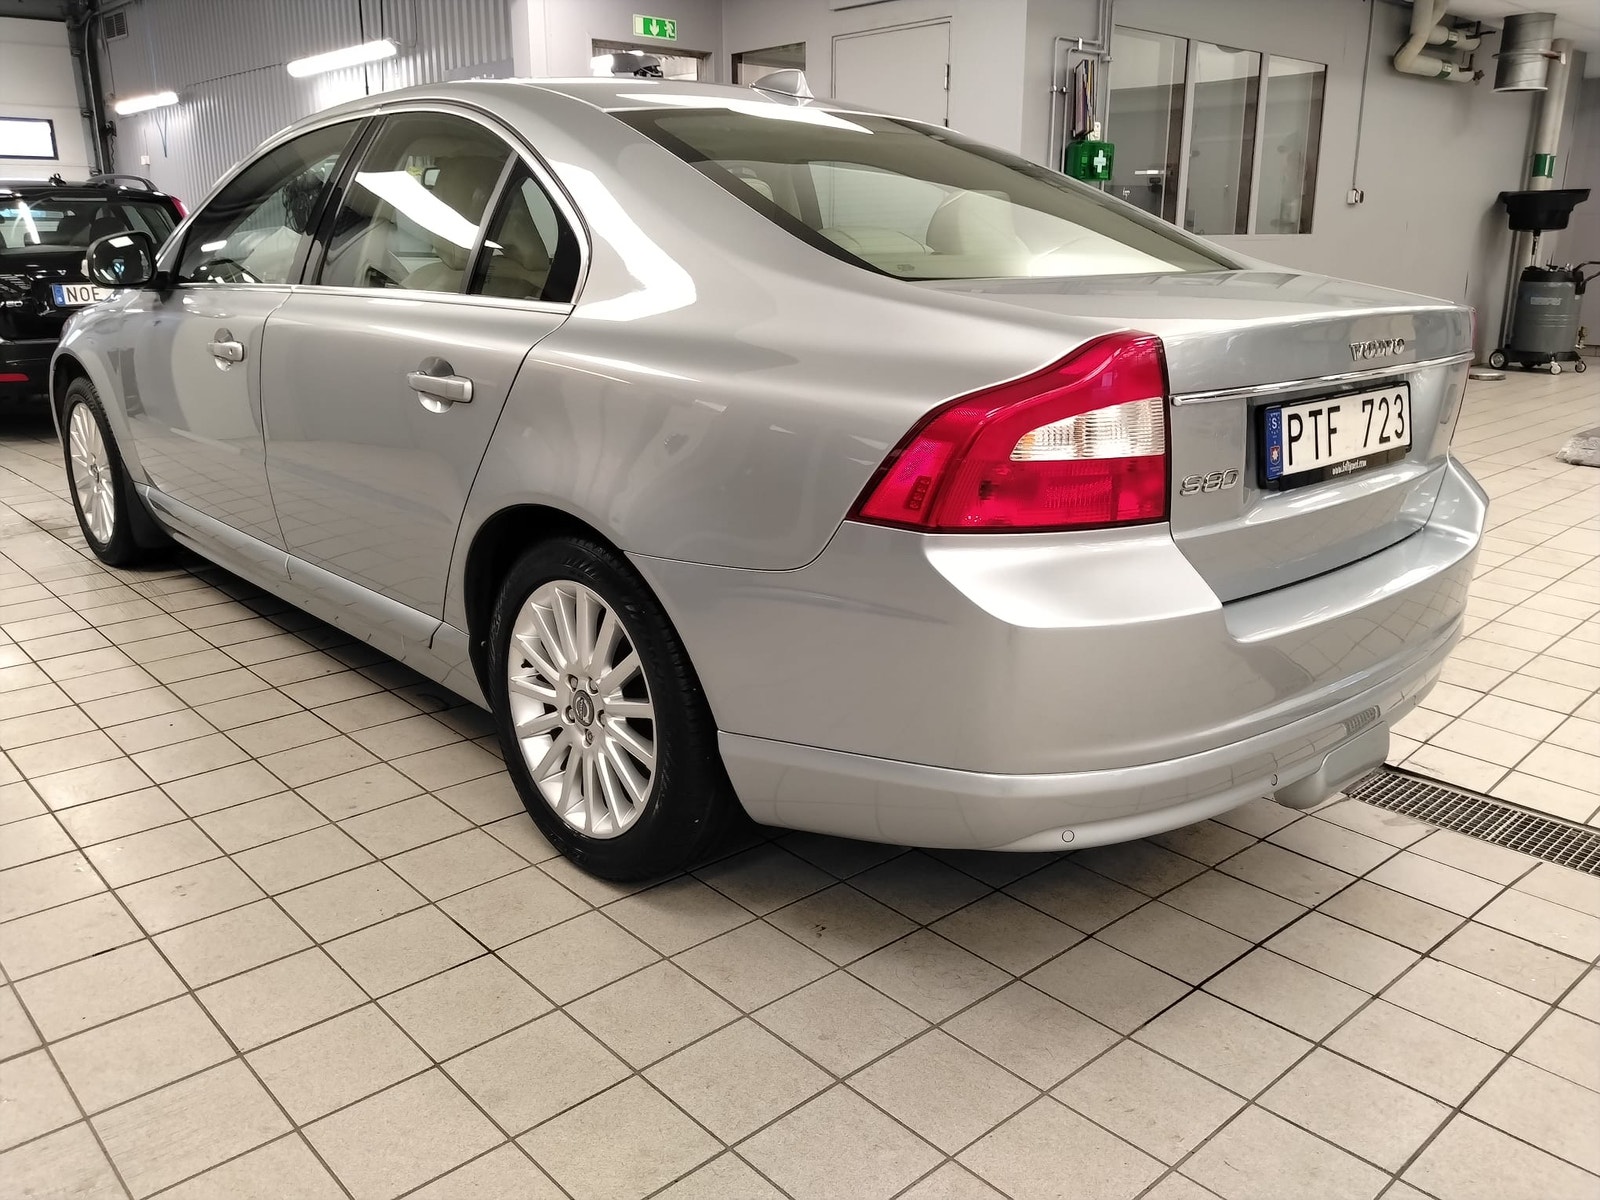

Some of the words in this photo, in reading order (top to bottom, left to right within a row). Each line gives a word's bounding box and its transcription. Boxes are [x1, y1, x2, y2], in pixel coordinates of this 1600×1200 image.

[65, 286, 102, 303] NOE
[1349, 338, 1405, 361] VOLVO
[1271, 417, 1278, 429] S
[1287, 405, 1341, 466] PTF
[1361, 393, 1405, 448] 723
[1179, 468, 1239, 496] S80
